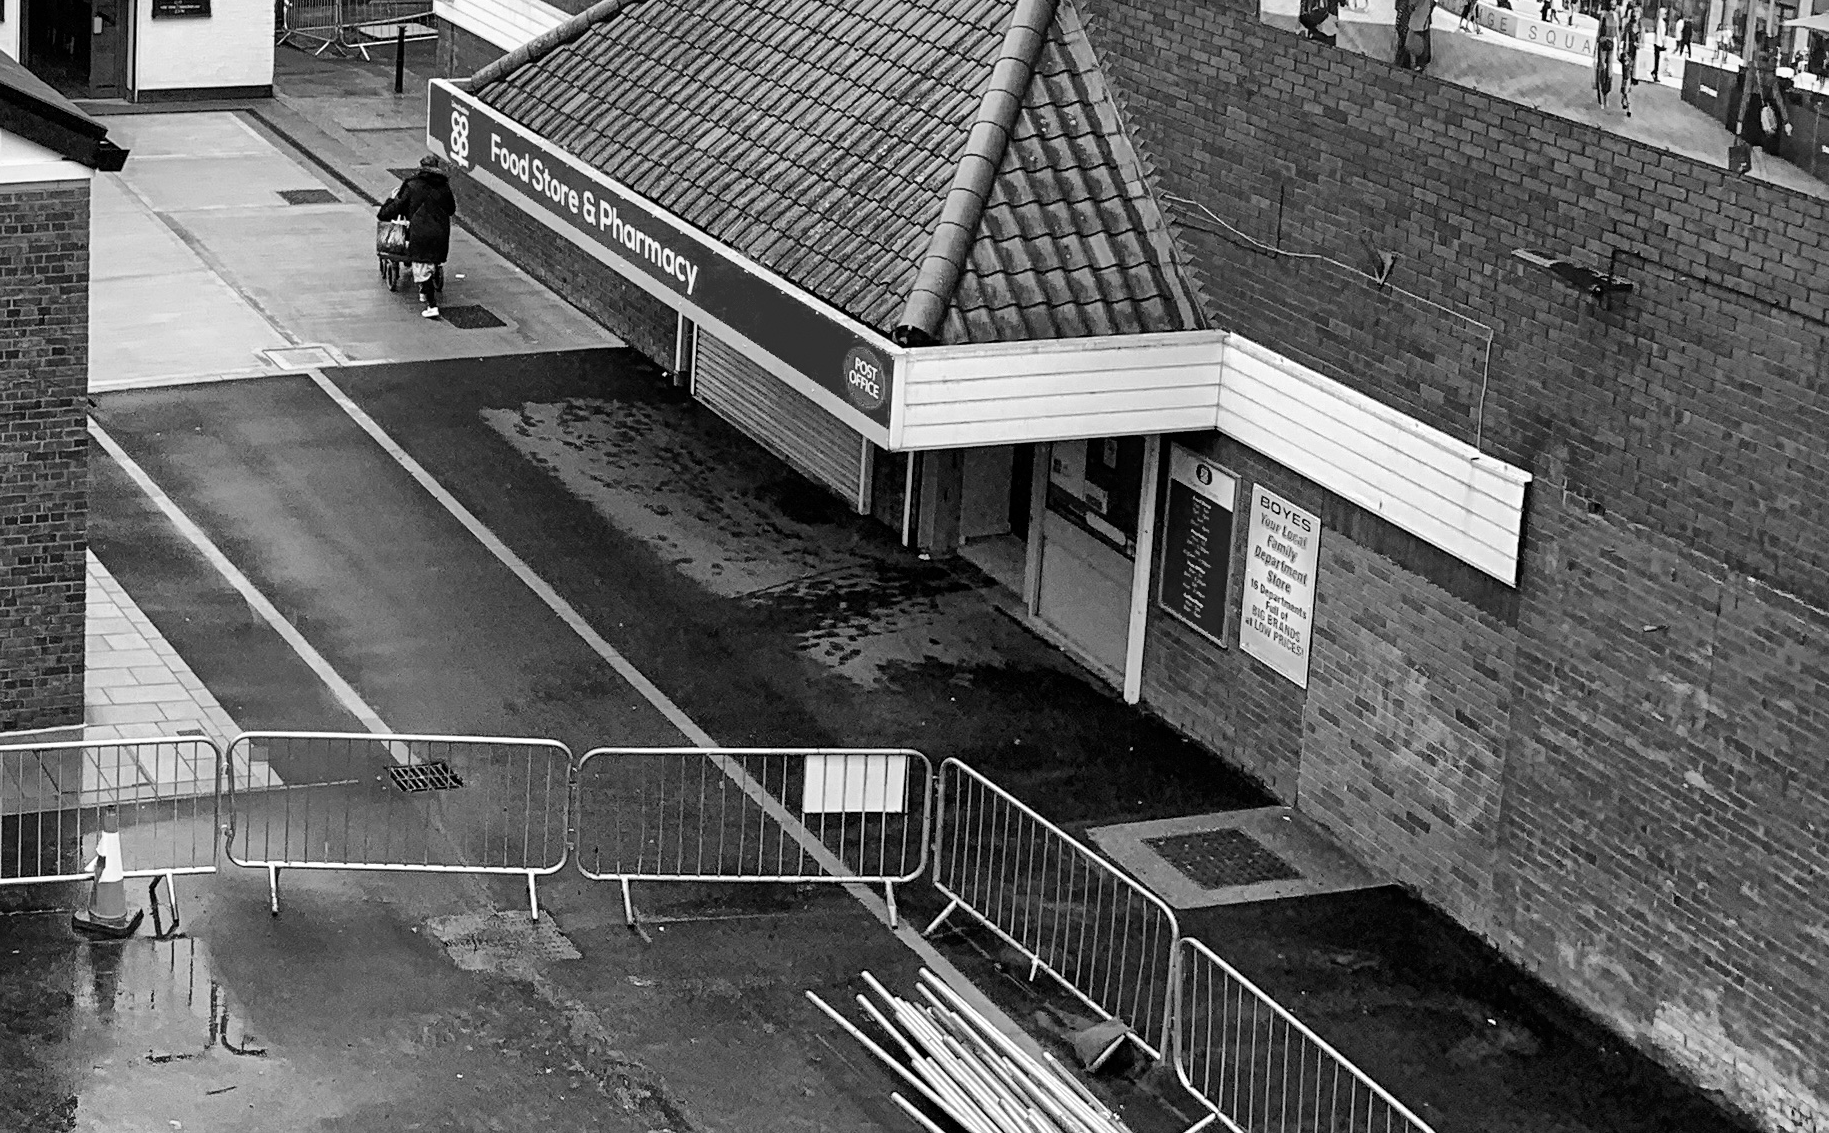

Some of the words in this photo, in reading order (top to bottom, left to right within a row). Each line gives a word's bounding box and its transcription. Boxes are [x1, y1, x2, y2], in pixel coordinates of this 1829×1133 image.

[1529, 25, 1592, 54] SQUA
[490, 133, 530, 183] Food
[532, 157, 579, 215] Store
[582, 190, 597, 225] &
[599, 201, 699, 295] Pharmacy
[855, 356, 878, 381] POST
[849, 369, 880, 399] OFFICE
[1260, 494, 1312, 533] BOYES
[1260, 513, 1282, 535] Your
[1282, 527, 1308, 550] Local
[1267, 535, 1299, 563] Family
[1255, 545, 1308, 588] Department
[1267, 569, 1292, 595] Store
[1259, 584, 1307, 620] Departments
[1265, 600, 1279, 616] Full
[1280, 610, 1289, 622] of
[1251, 604, 1266, 624] BIG
[1266, 614, 1301, 643] BRANDS
[1253, 619, 1271, 640] LOW
